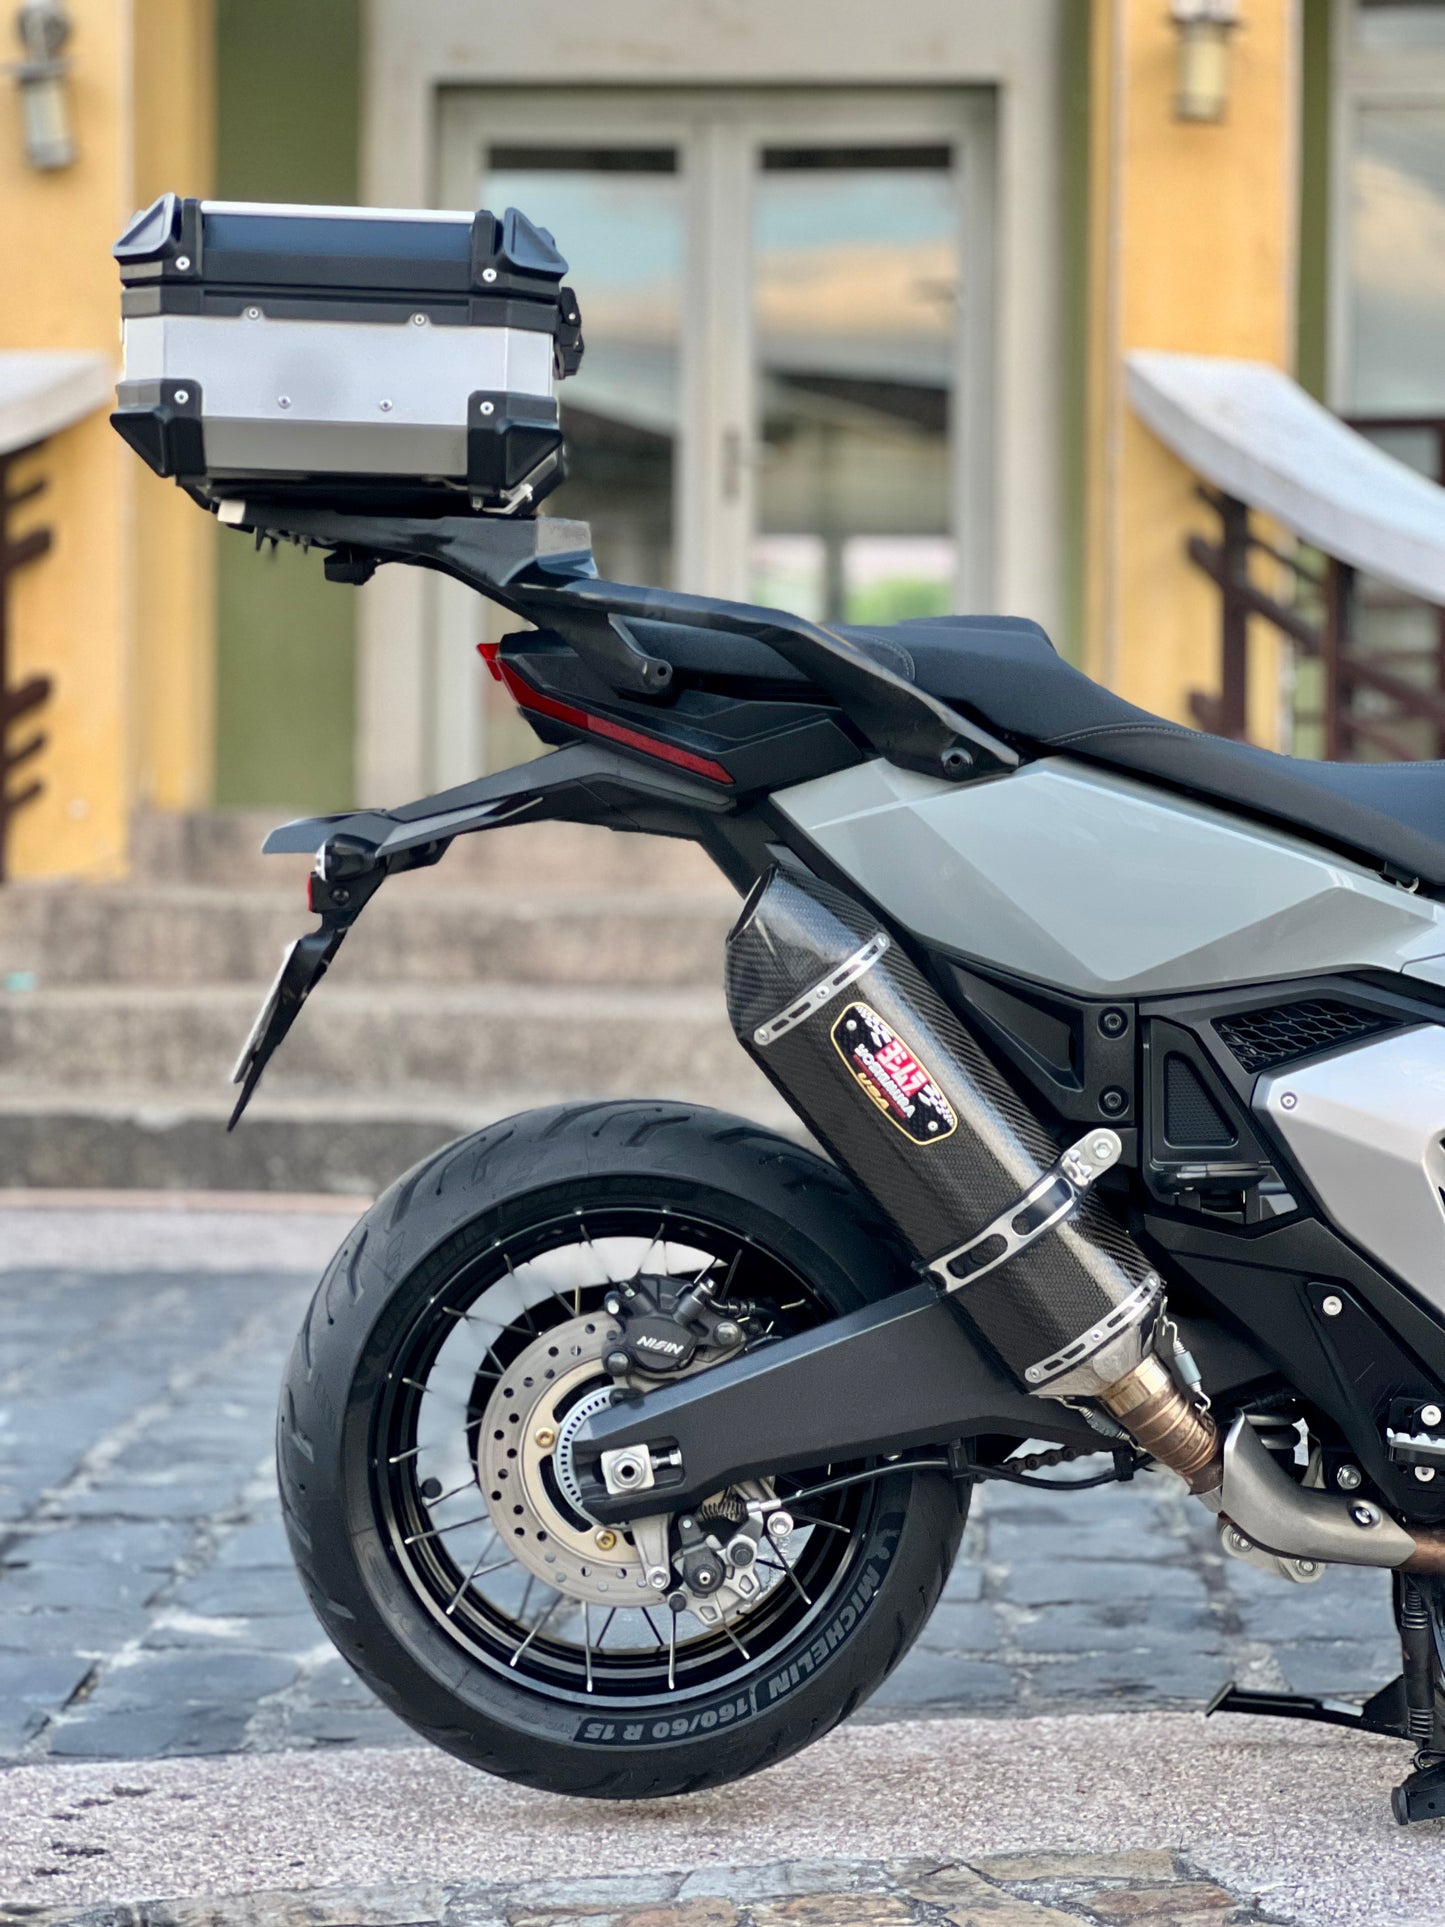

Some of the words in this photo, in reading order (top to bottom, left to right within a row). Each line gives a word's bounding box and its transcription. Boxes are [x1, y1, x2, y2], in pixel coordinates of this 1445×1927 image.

[854, 1043, 916, 1118] YOSHIMURA
[875, 1039, 928, 1095] ヨシムラ
[857, 1072, 890, 1110] USA
[768, 1564, 881, 1699] MICHELIN
[583, 1722, 616, 1741] 15
[622, 1723, 645, 1741] R
[652, 1697, 749, 1739] 160/60
